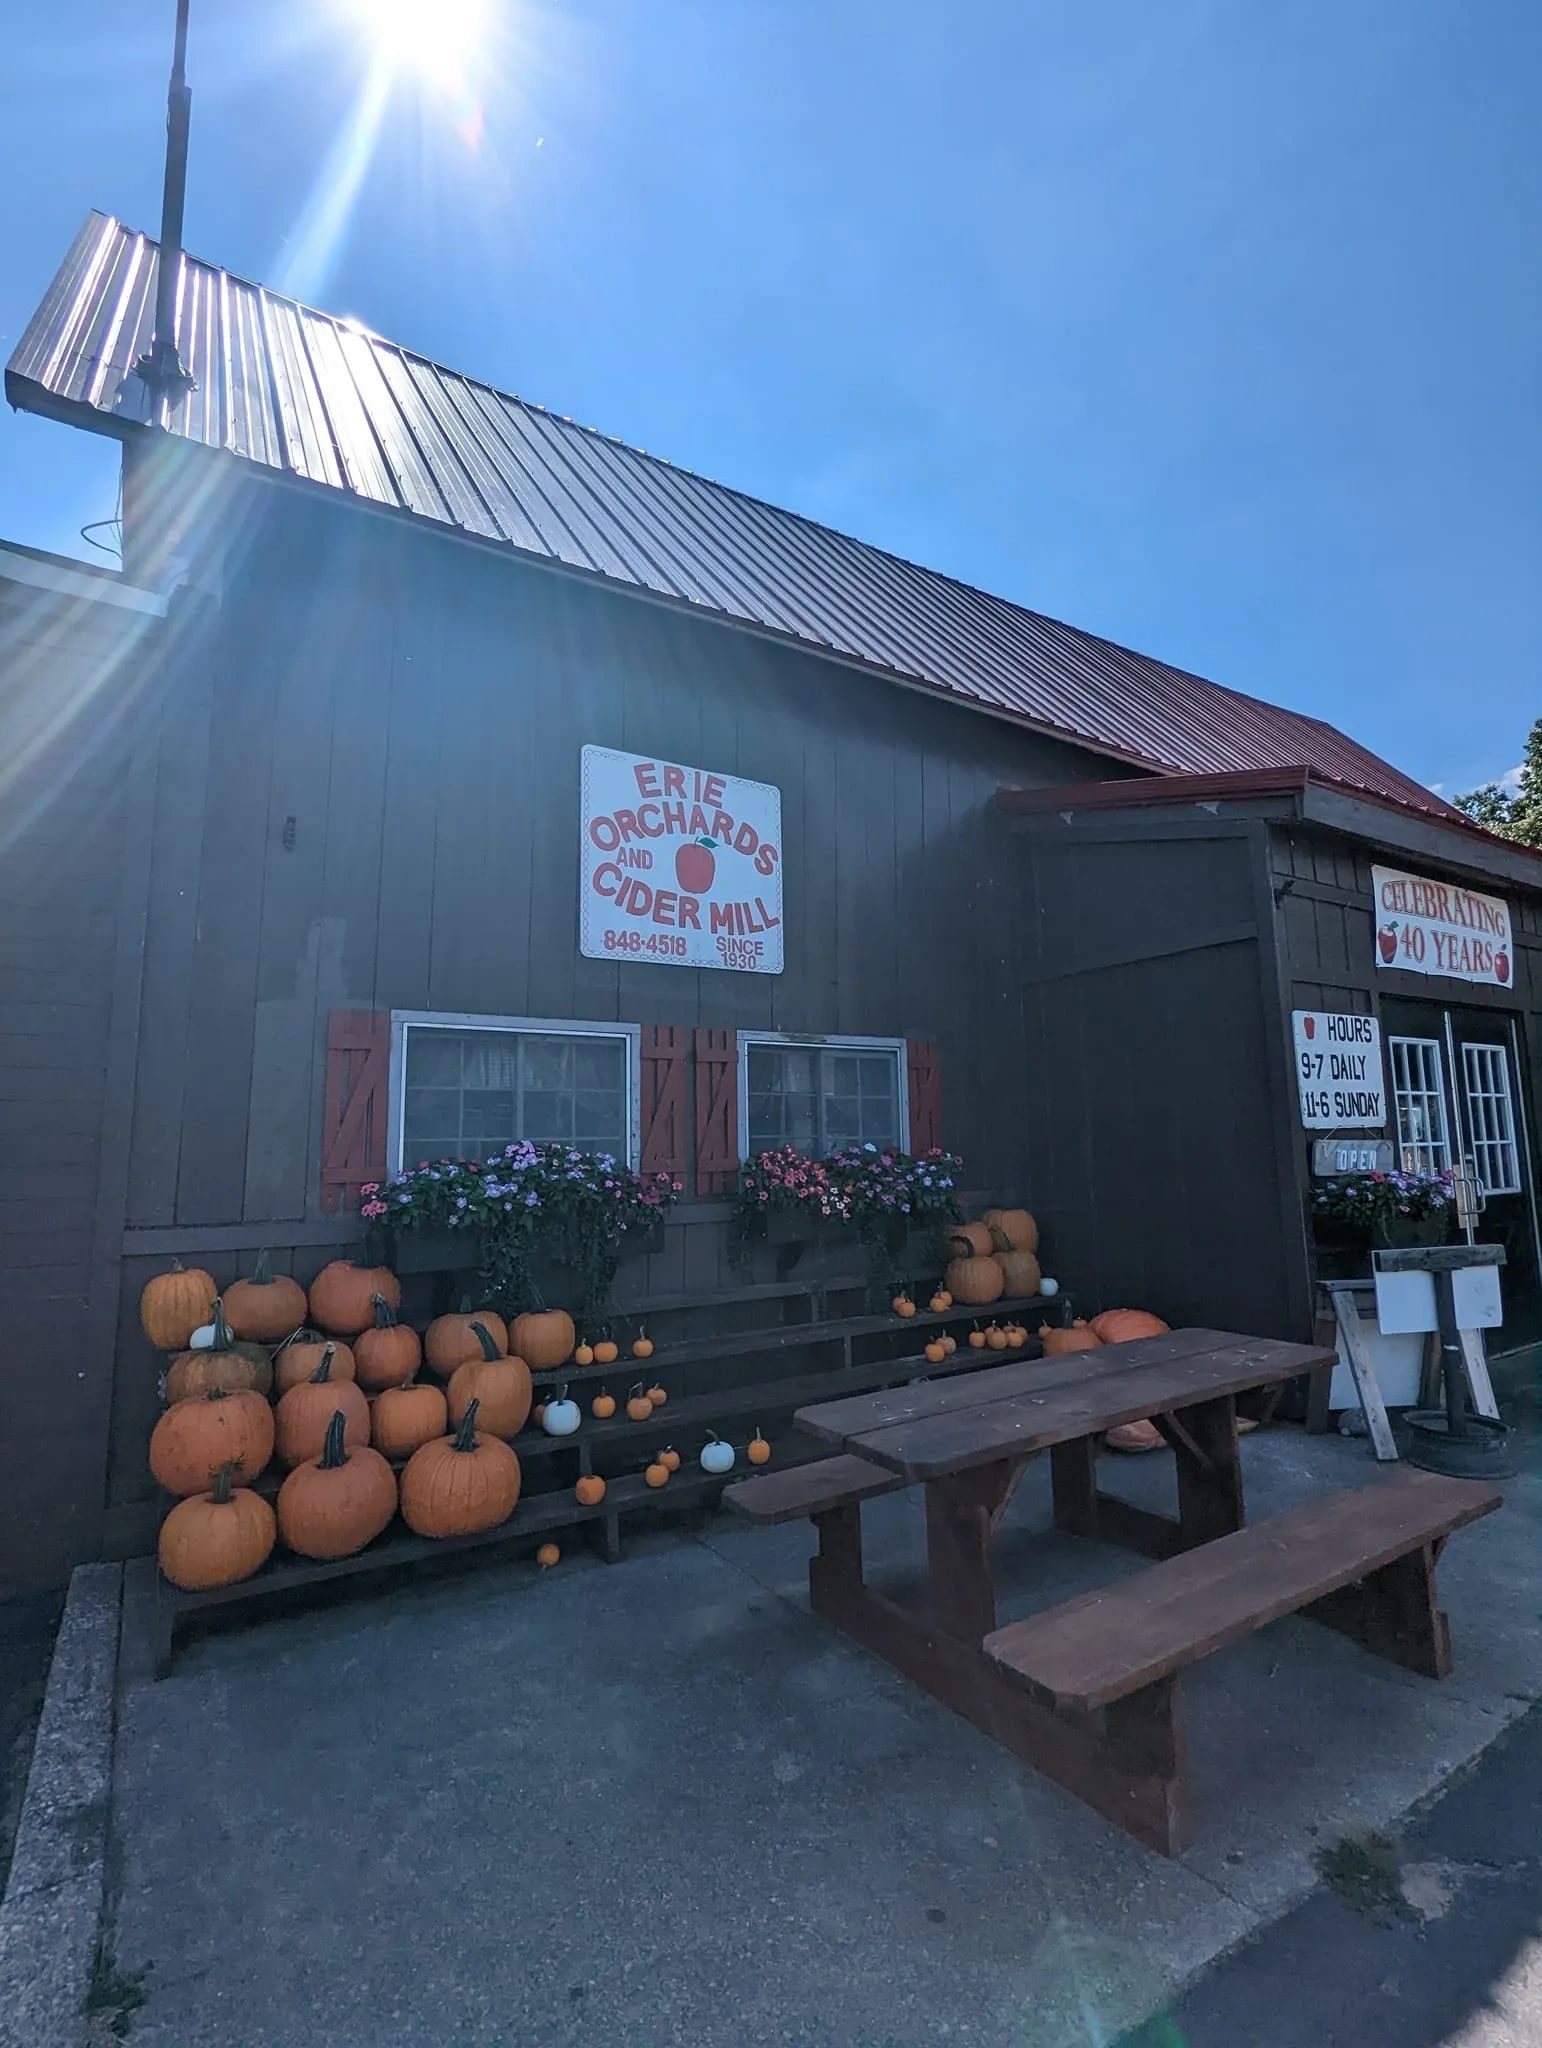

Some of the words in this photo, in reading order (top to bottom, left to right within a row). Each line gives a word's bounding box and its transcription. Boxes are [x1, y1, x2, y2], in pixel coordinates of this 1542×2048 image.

[633, 763, 727, 809] ERIE
[589, 801, 778, 876] ORCHARDS
[616, 847, 653, 870] AND
[592, 862, 702, 930] CIDER
[710, 897, 780, 936] MILL
[1381, 879, 1505, 938] CELEBRATING
[716, 936, 764, 956] SINCE
[1400, 923, 1425, 963] 40
[1431, 931, 1493, 975] YEARS
[720, 952, 756, 970] 1930
[1327, 1016, 1372, 1043] HOURS
[1301, 1052, 1323, 1080] 9-7
[1331, 1053, 1366, 1081] DAILY
[1305, 1093, 1329, 1118] 11-6
[1335, 1092, 1380, 1118] SUNDAY
[1335, 1149, 1377, 1171] OPEN
